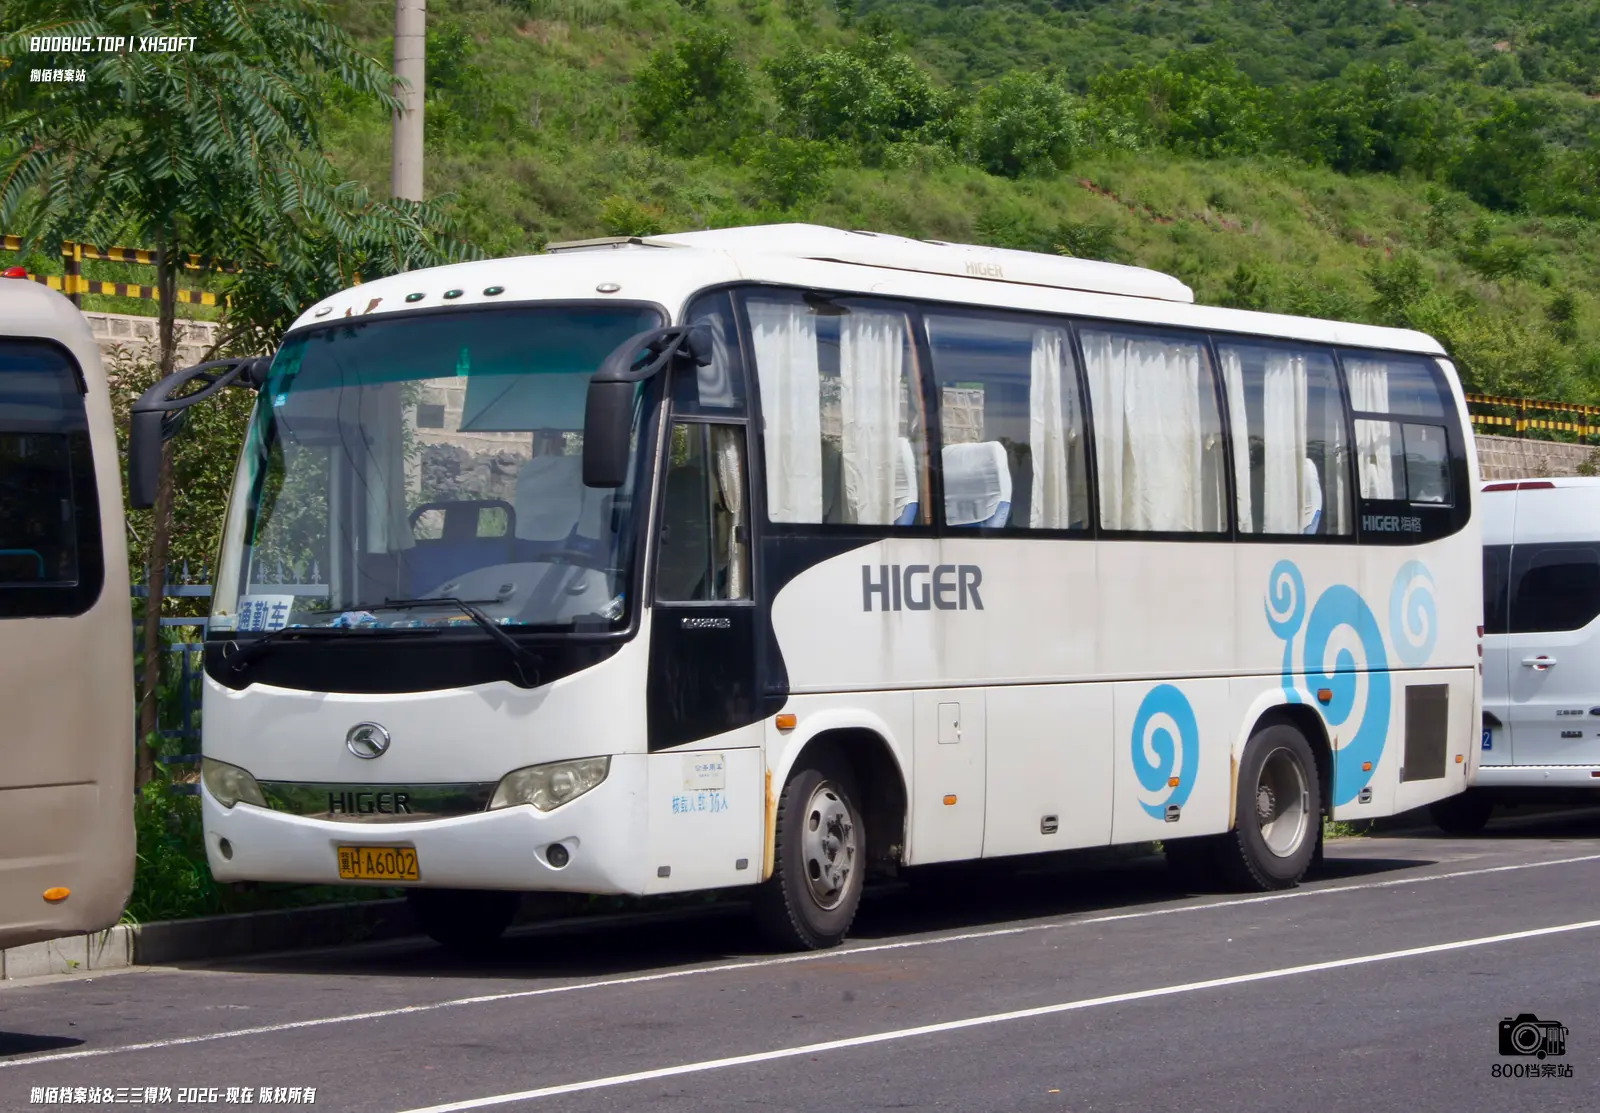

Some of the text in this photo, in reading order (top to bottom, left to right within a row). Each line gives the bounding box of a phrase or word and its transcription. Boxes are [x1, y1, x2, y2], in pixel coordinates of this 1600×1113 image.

[965, 261, 1004, 278] HIGER
[1362, 515, 1422, 533] HIGER 海格
[861, 564, 985, 612] HIGER
[238, 601, 288, 631] 通勤车
[328, 792, 412, 814] HIGER
